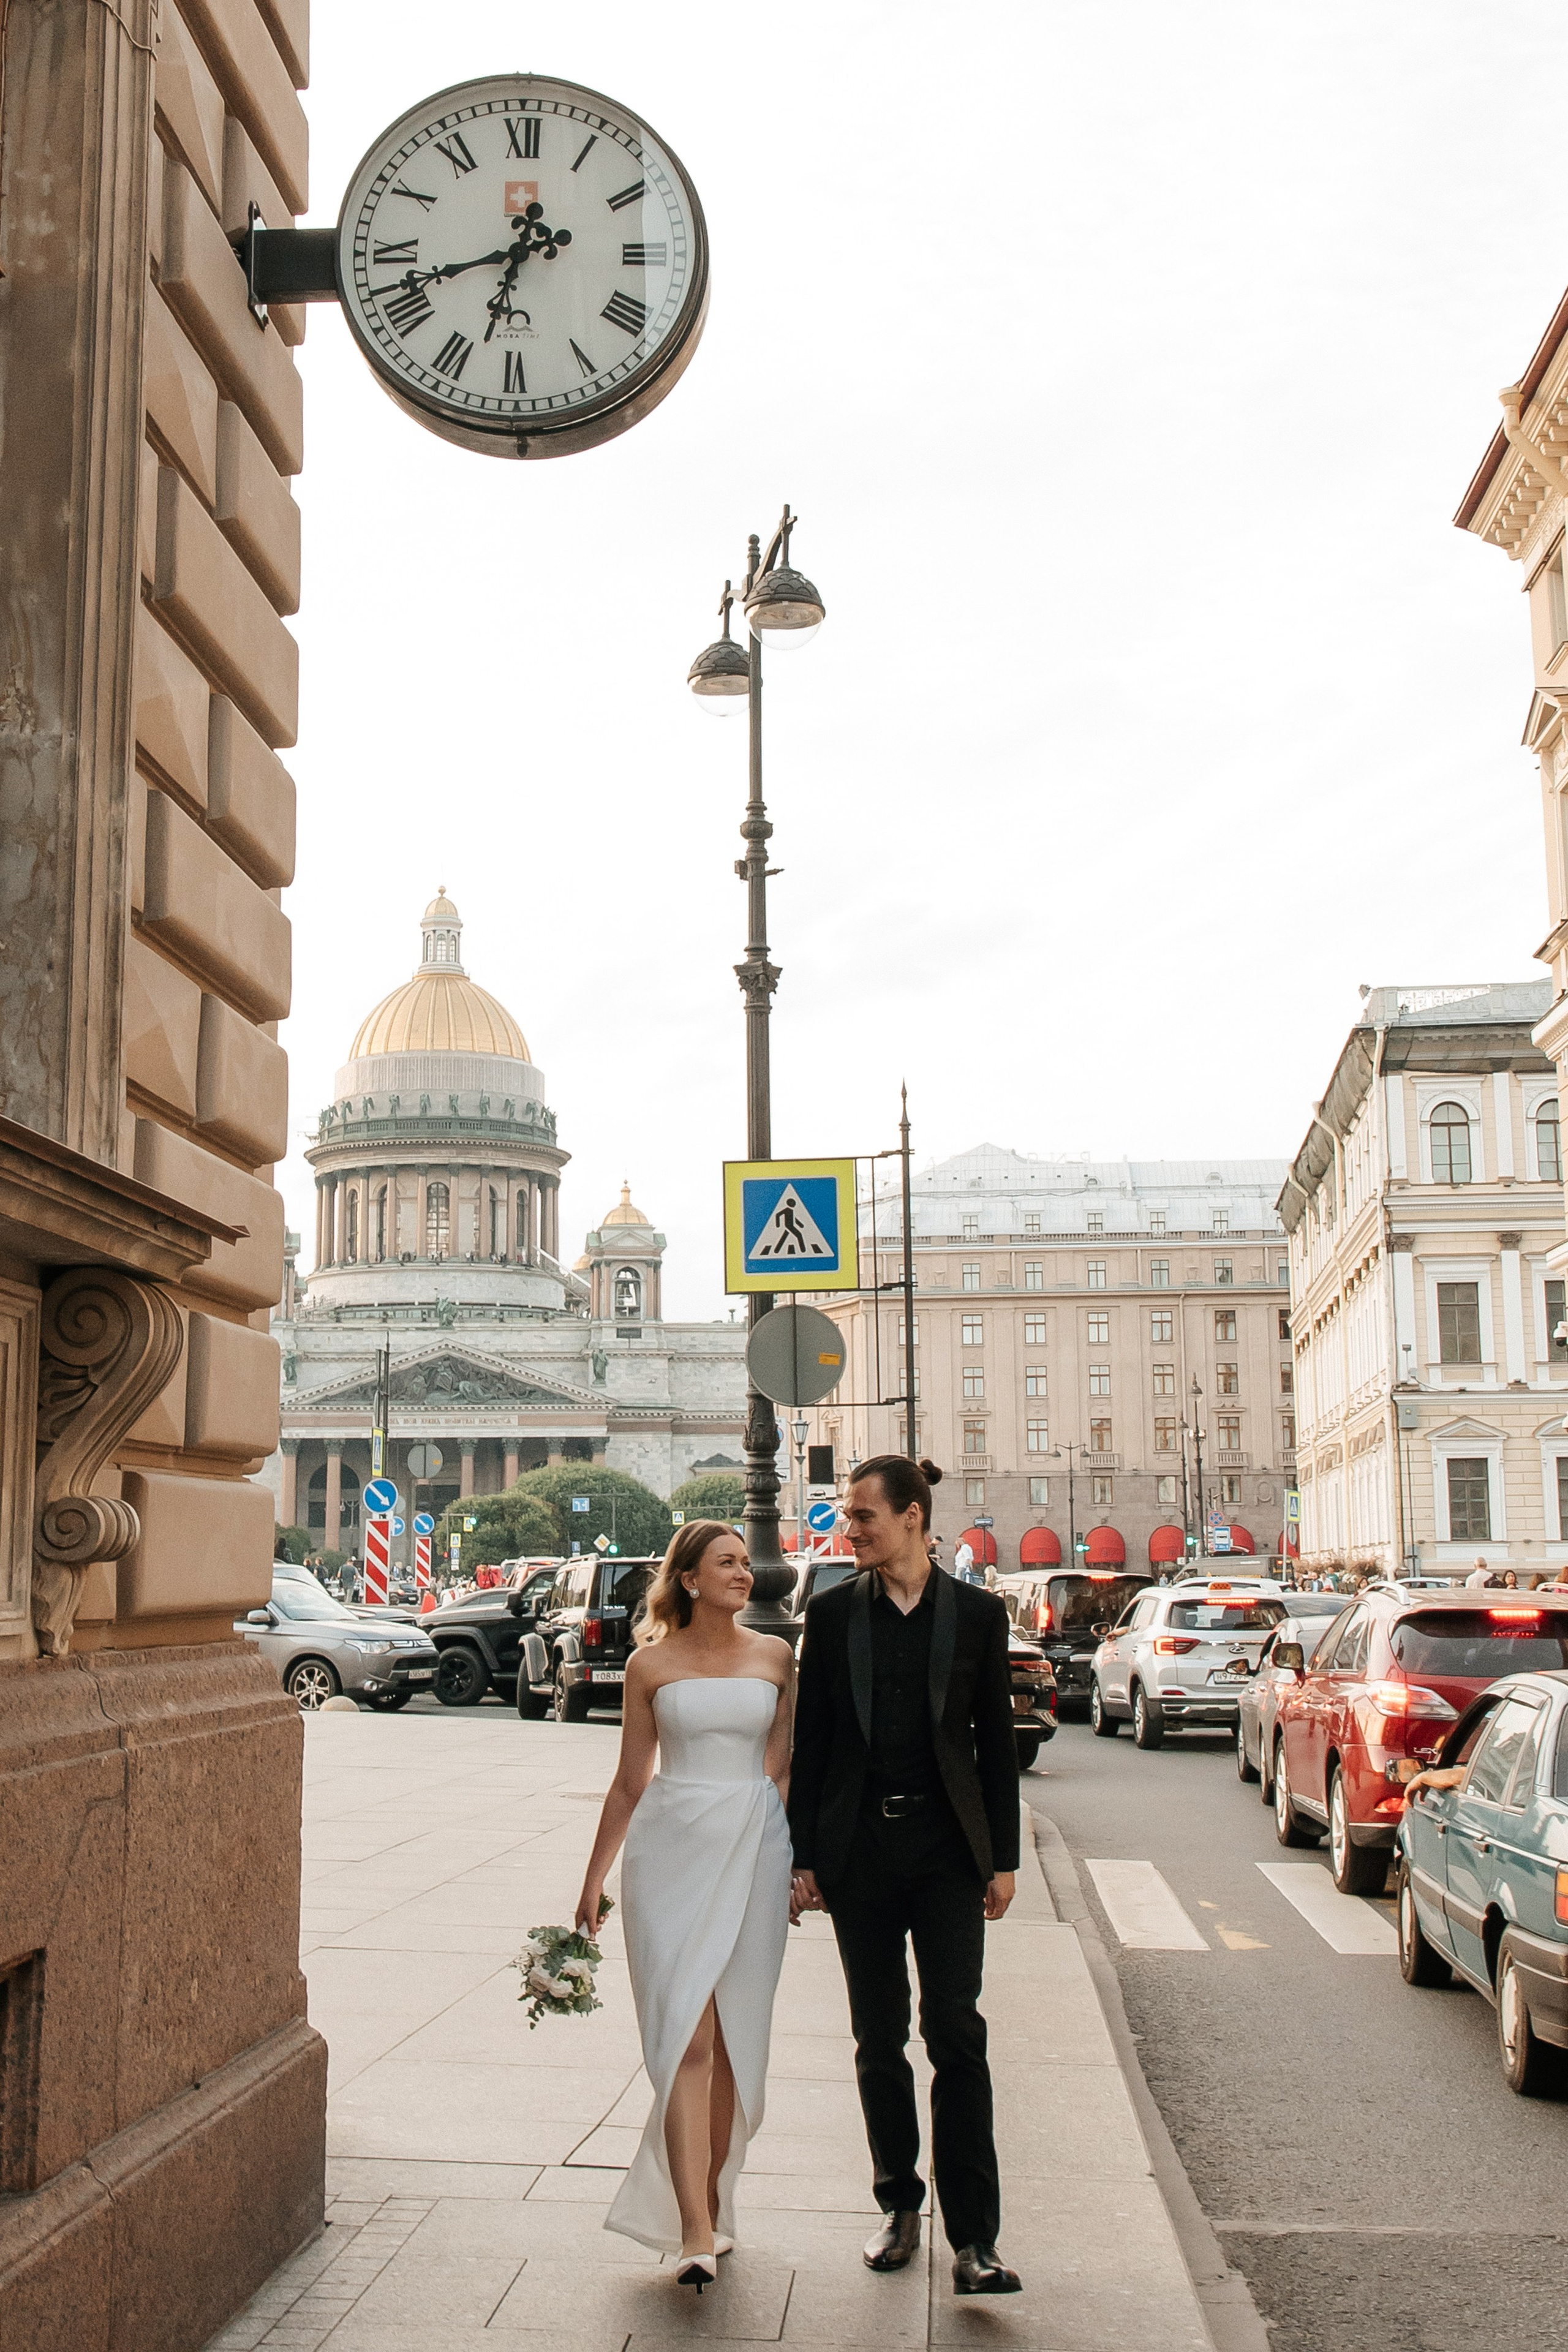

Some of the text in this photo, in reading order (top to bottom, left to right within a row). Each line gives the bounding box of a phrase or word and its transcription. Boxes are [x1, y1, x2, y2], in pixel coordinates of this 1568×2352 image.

[433, 131, 479, 179] XI
[503, 118, 543, 159] XII
[570, 134, 599, 173] I
[390, 178, 438, 213] X
[606, 178, 652, 213] II
[373, 238, 419, 265] IX
[622, 242, 666, 266] III
[382, 288, 435, 339] VIII
[599, 289, 654, 338] IIII
[430, 330, 474, 382] VII
[502, 350, 527, 393] VI
[569, 338, 598, 378] V
